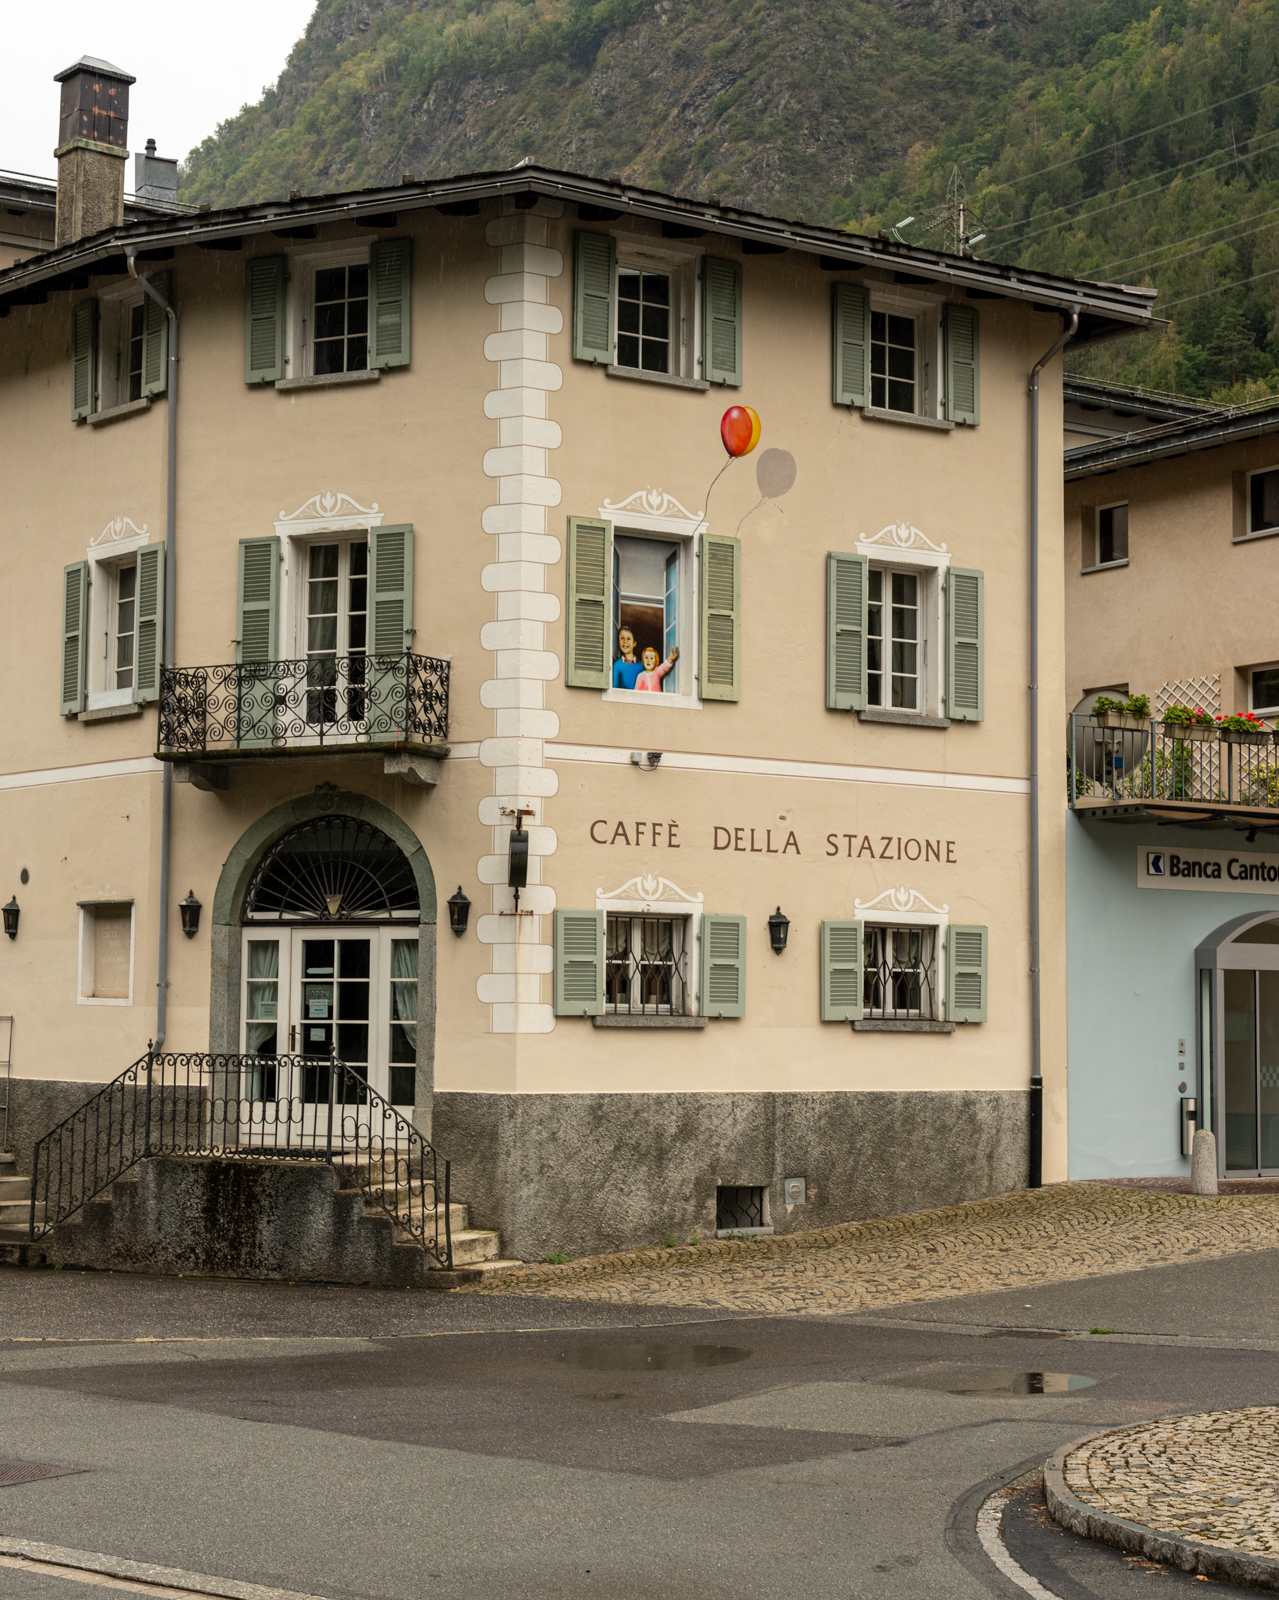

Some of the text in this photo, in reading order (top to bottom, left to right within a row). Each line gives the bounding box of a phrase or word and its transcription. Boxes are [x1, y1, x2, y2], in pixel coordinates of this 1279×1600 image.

[589, 818, 958, 864] CAFFÈ DELLA STAZIONE
[1169, 854, 1279, 882] Banca Canto
